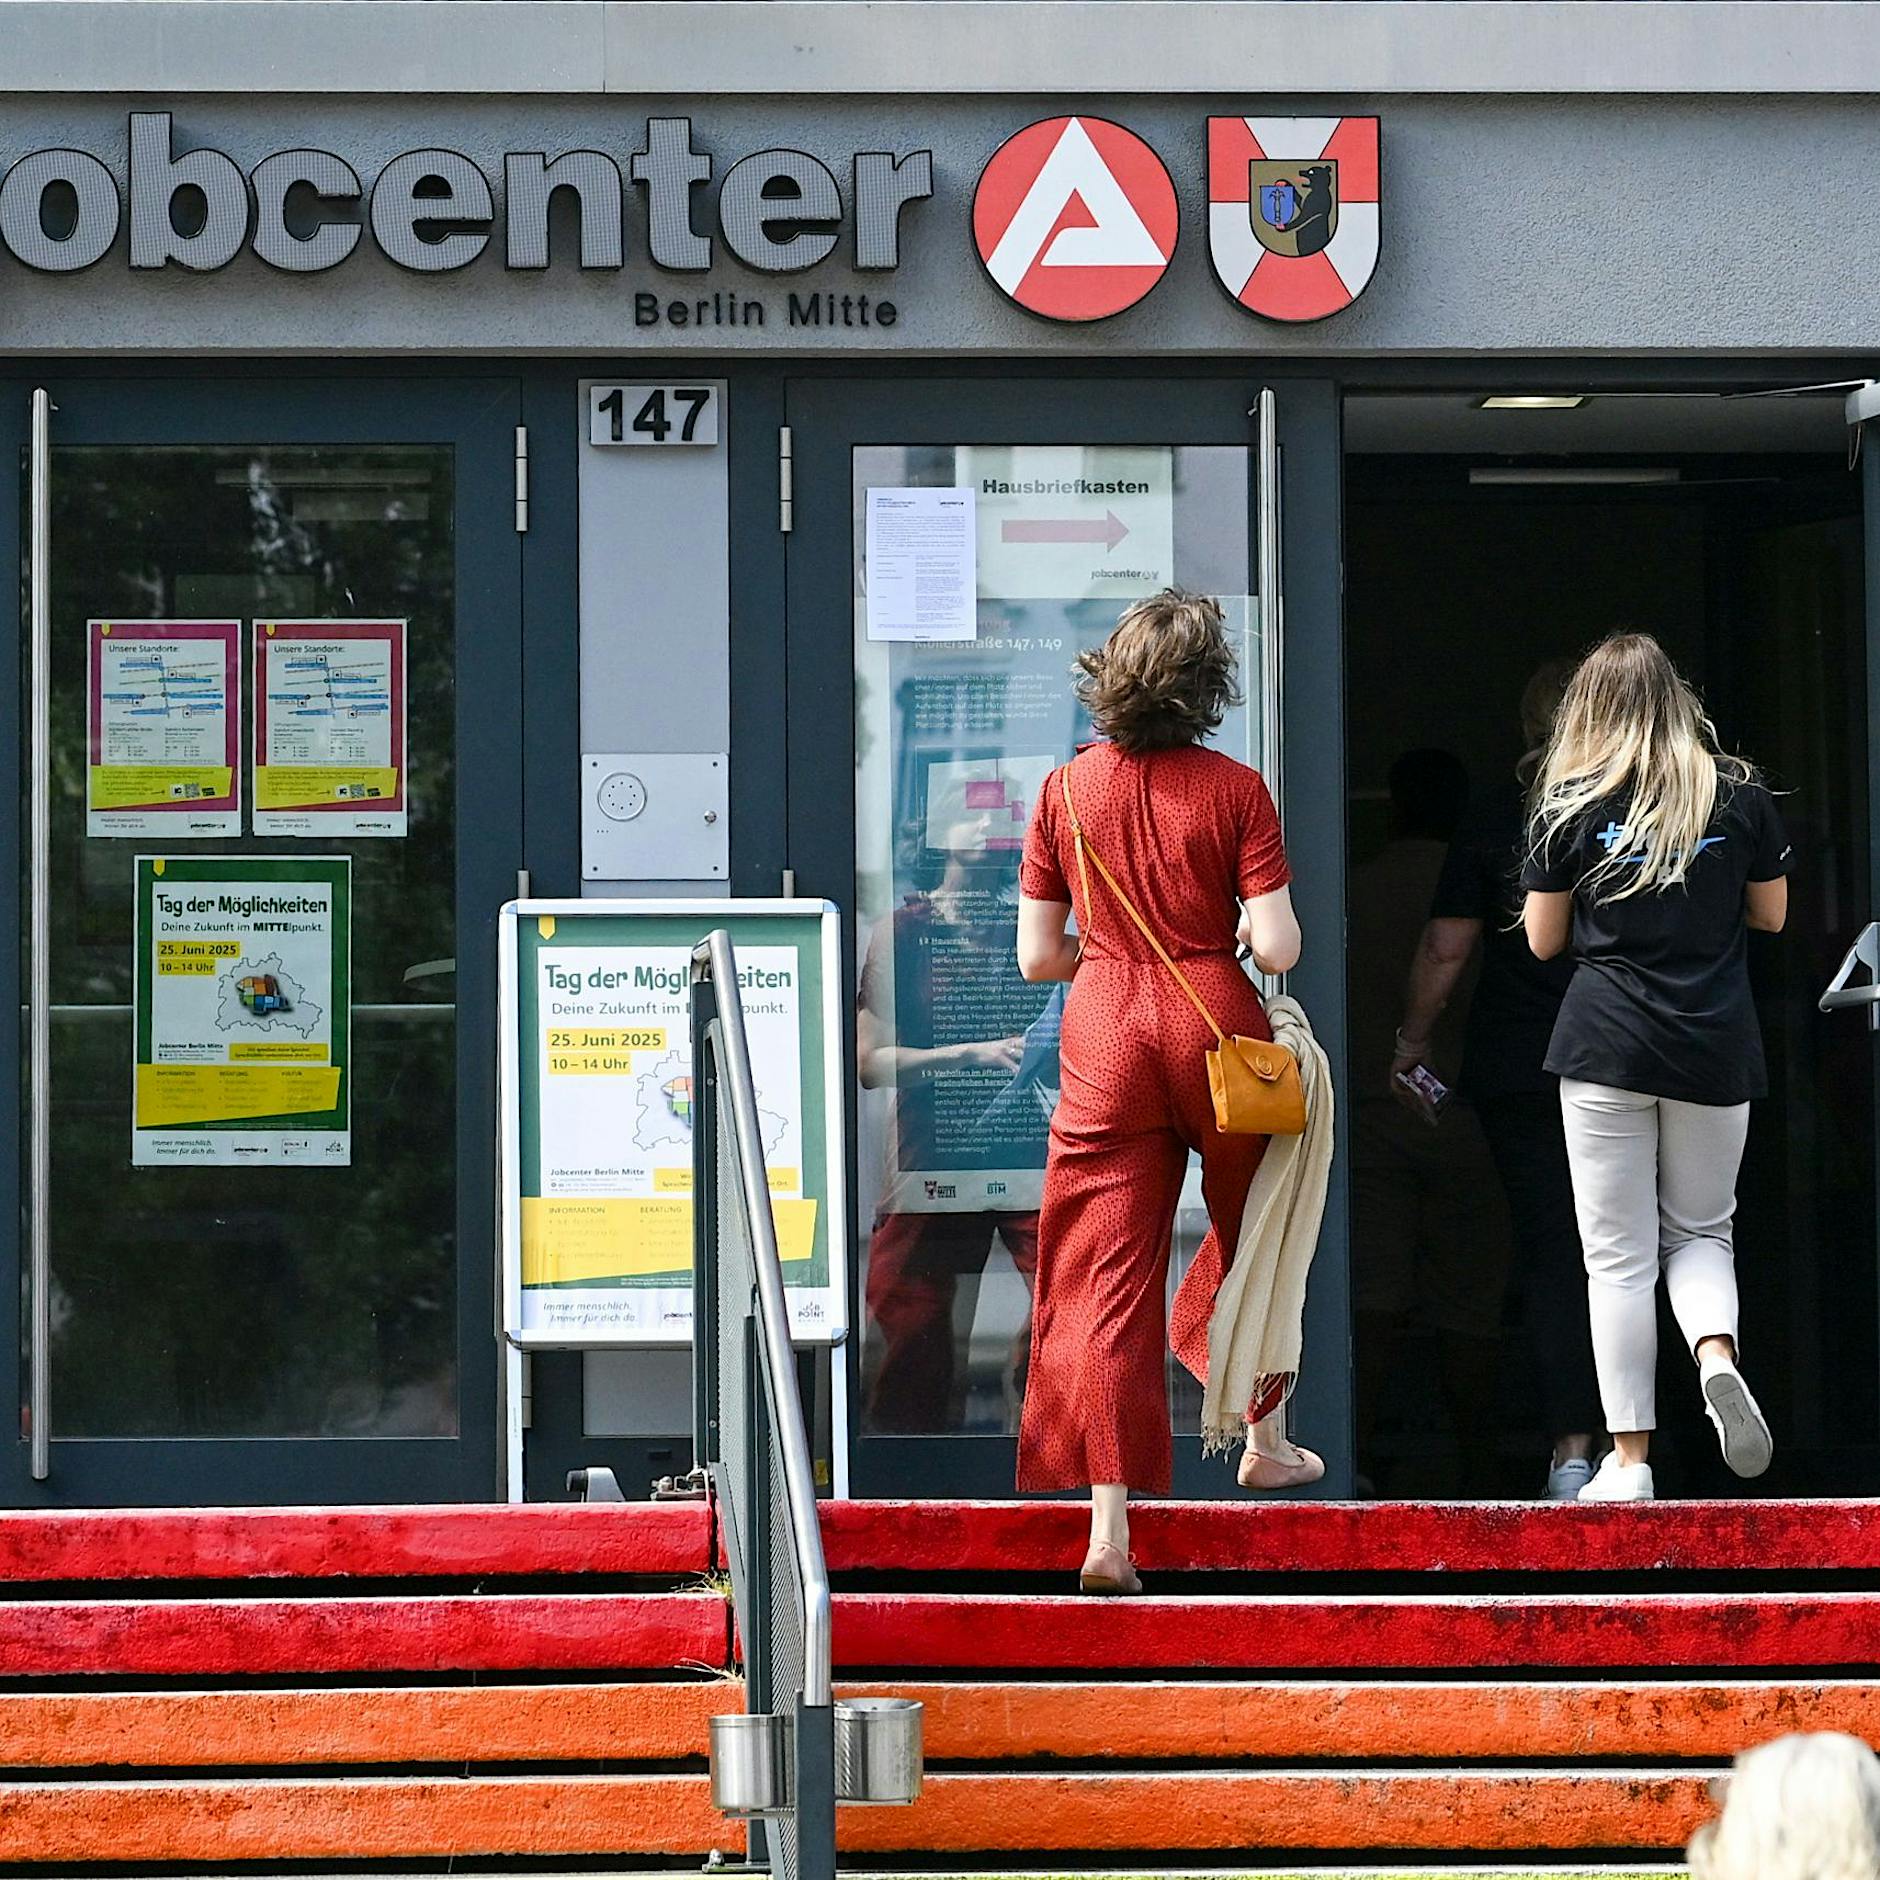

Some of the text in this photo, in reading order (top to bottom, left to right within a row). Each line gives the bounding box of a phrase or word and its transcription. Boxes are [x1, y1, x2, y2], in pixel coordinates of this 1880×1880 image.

[634, 292, 897, 327] Berlin Mitte
[598, 389, 710, 441] 147
[983, 479, 1149, 494] Hausbriefkasten
[1091, 569, 1141, 579] jobcenter
[109, 644, 137, 653] Unsere
[274, 644, 302, 653] Unsere
[1007, 637, 1034, 651] 147,
[1039, 637, 1062, 651] 149
[157, 895, 327, 917] Tag der Möglichkeiten
[161, 922, 324, 934] Deine Zukunft im MITTElpunkt.
[160, 944, 237, 955] 25. Juni 2025
[160, 962, 172, 971] 10
[182, 962, 193, 971] 14
[196, 962, 214, 971] Uhr
[545, 964, 792, 995] Tag der Mögleiten
[552, 1002, 594, 1014] Deine
[599, 1002, 657, 1015] Zukunft
[662, 1002, 681, 1014] im
[551, 1033, 662, 1047] 25. Juni 2025
[551, 1058, 568, 1069] 10
[583, 1058, 598, 1069] 14
[603, 1058, 629, 1070] Uhr
[179, 1147, 190, 1156] für
[550, 1168, 645, 1177] Jobcenter Berlin Mitte
[544, 1301, 632, 1311] Immer menschlich.
[550, 1313, 582, 1322] Immer
[583, 1313, 598, 1324] für
[600, 1313, 620, 1322] dich
